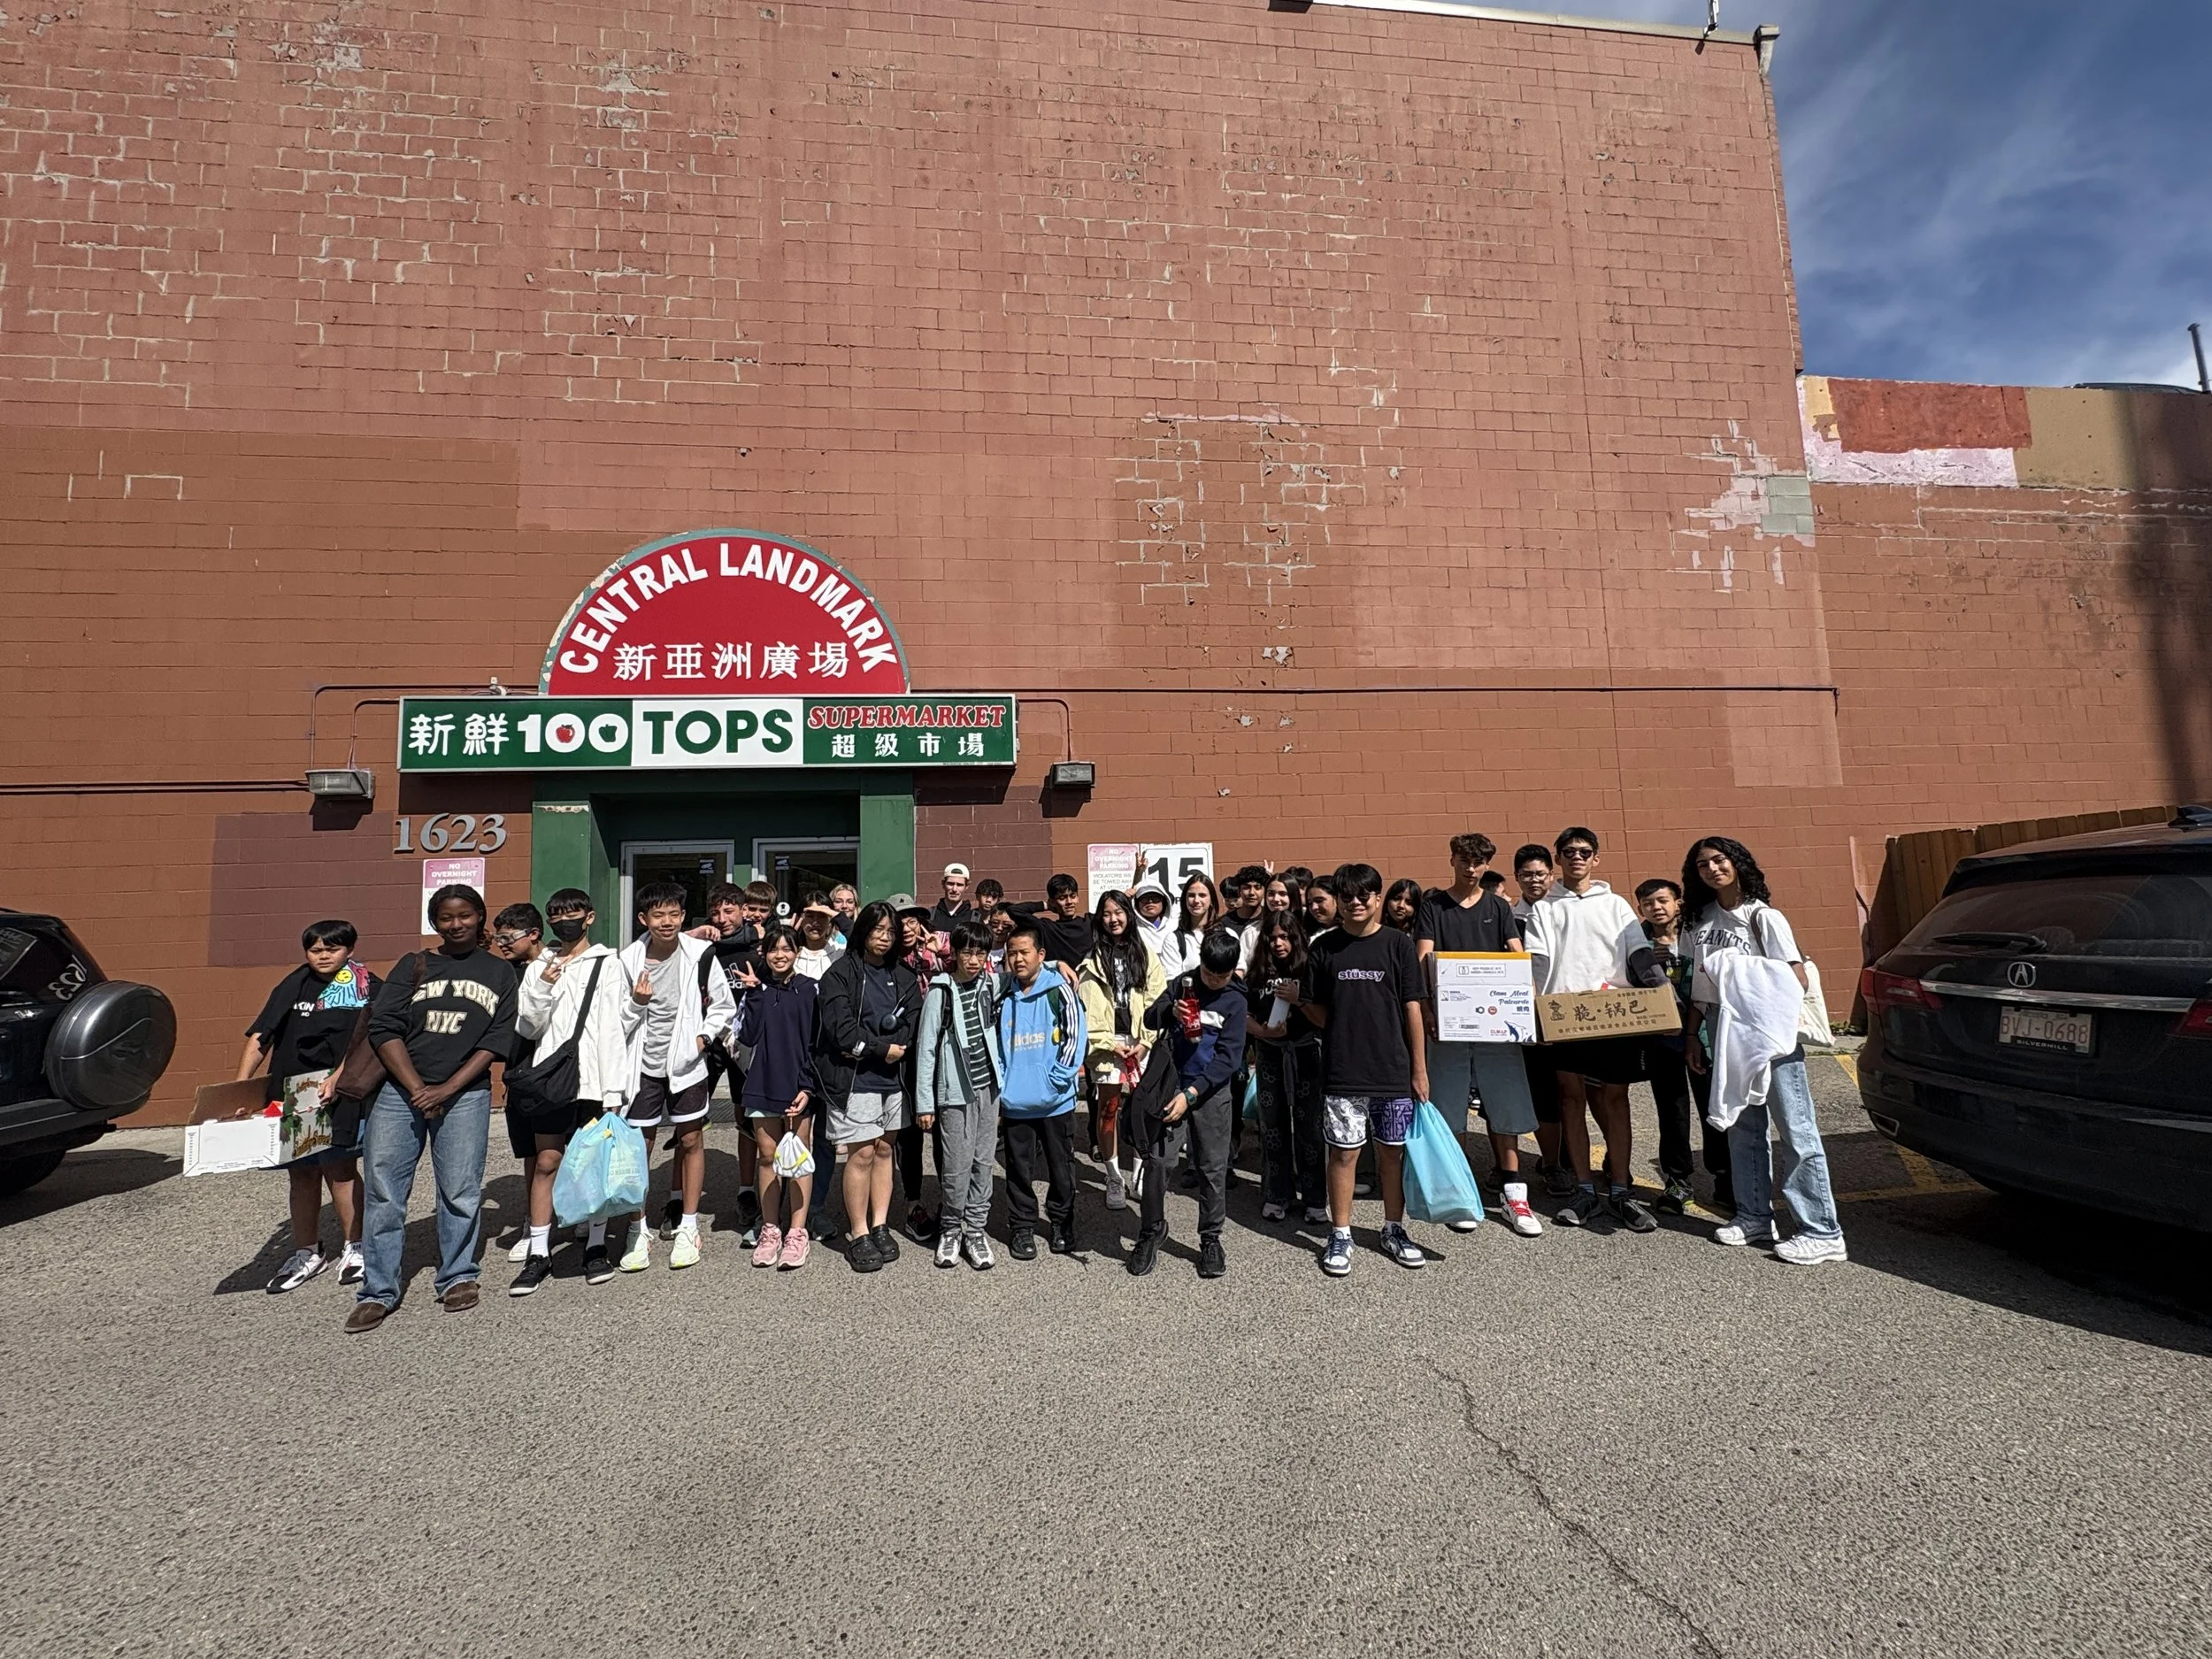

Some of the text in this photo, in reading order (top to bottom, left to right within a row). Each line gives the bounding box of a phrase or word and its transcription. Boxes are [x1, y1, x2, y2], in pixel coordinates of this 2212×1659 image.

[560, 543, 897, 673] CENTRAL LANDMARK
[408, 709, 793, 756] 新鮮 100 TOPS
[807, 705, 1006, 729] SUPERMARKET
[831, 733, 984, 757] 超級市場
[394, 812, 507, 854] 1623
[1148, 857, 1204, 894] 15
[1694, 929, 1751, 955] EANUTS
[1338, 968, 1386, 982] stüssy
[451, 979, 500, 1018] YORK
[424, 1010, 468, 1034] NYC
